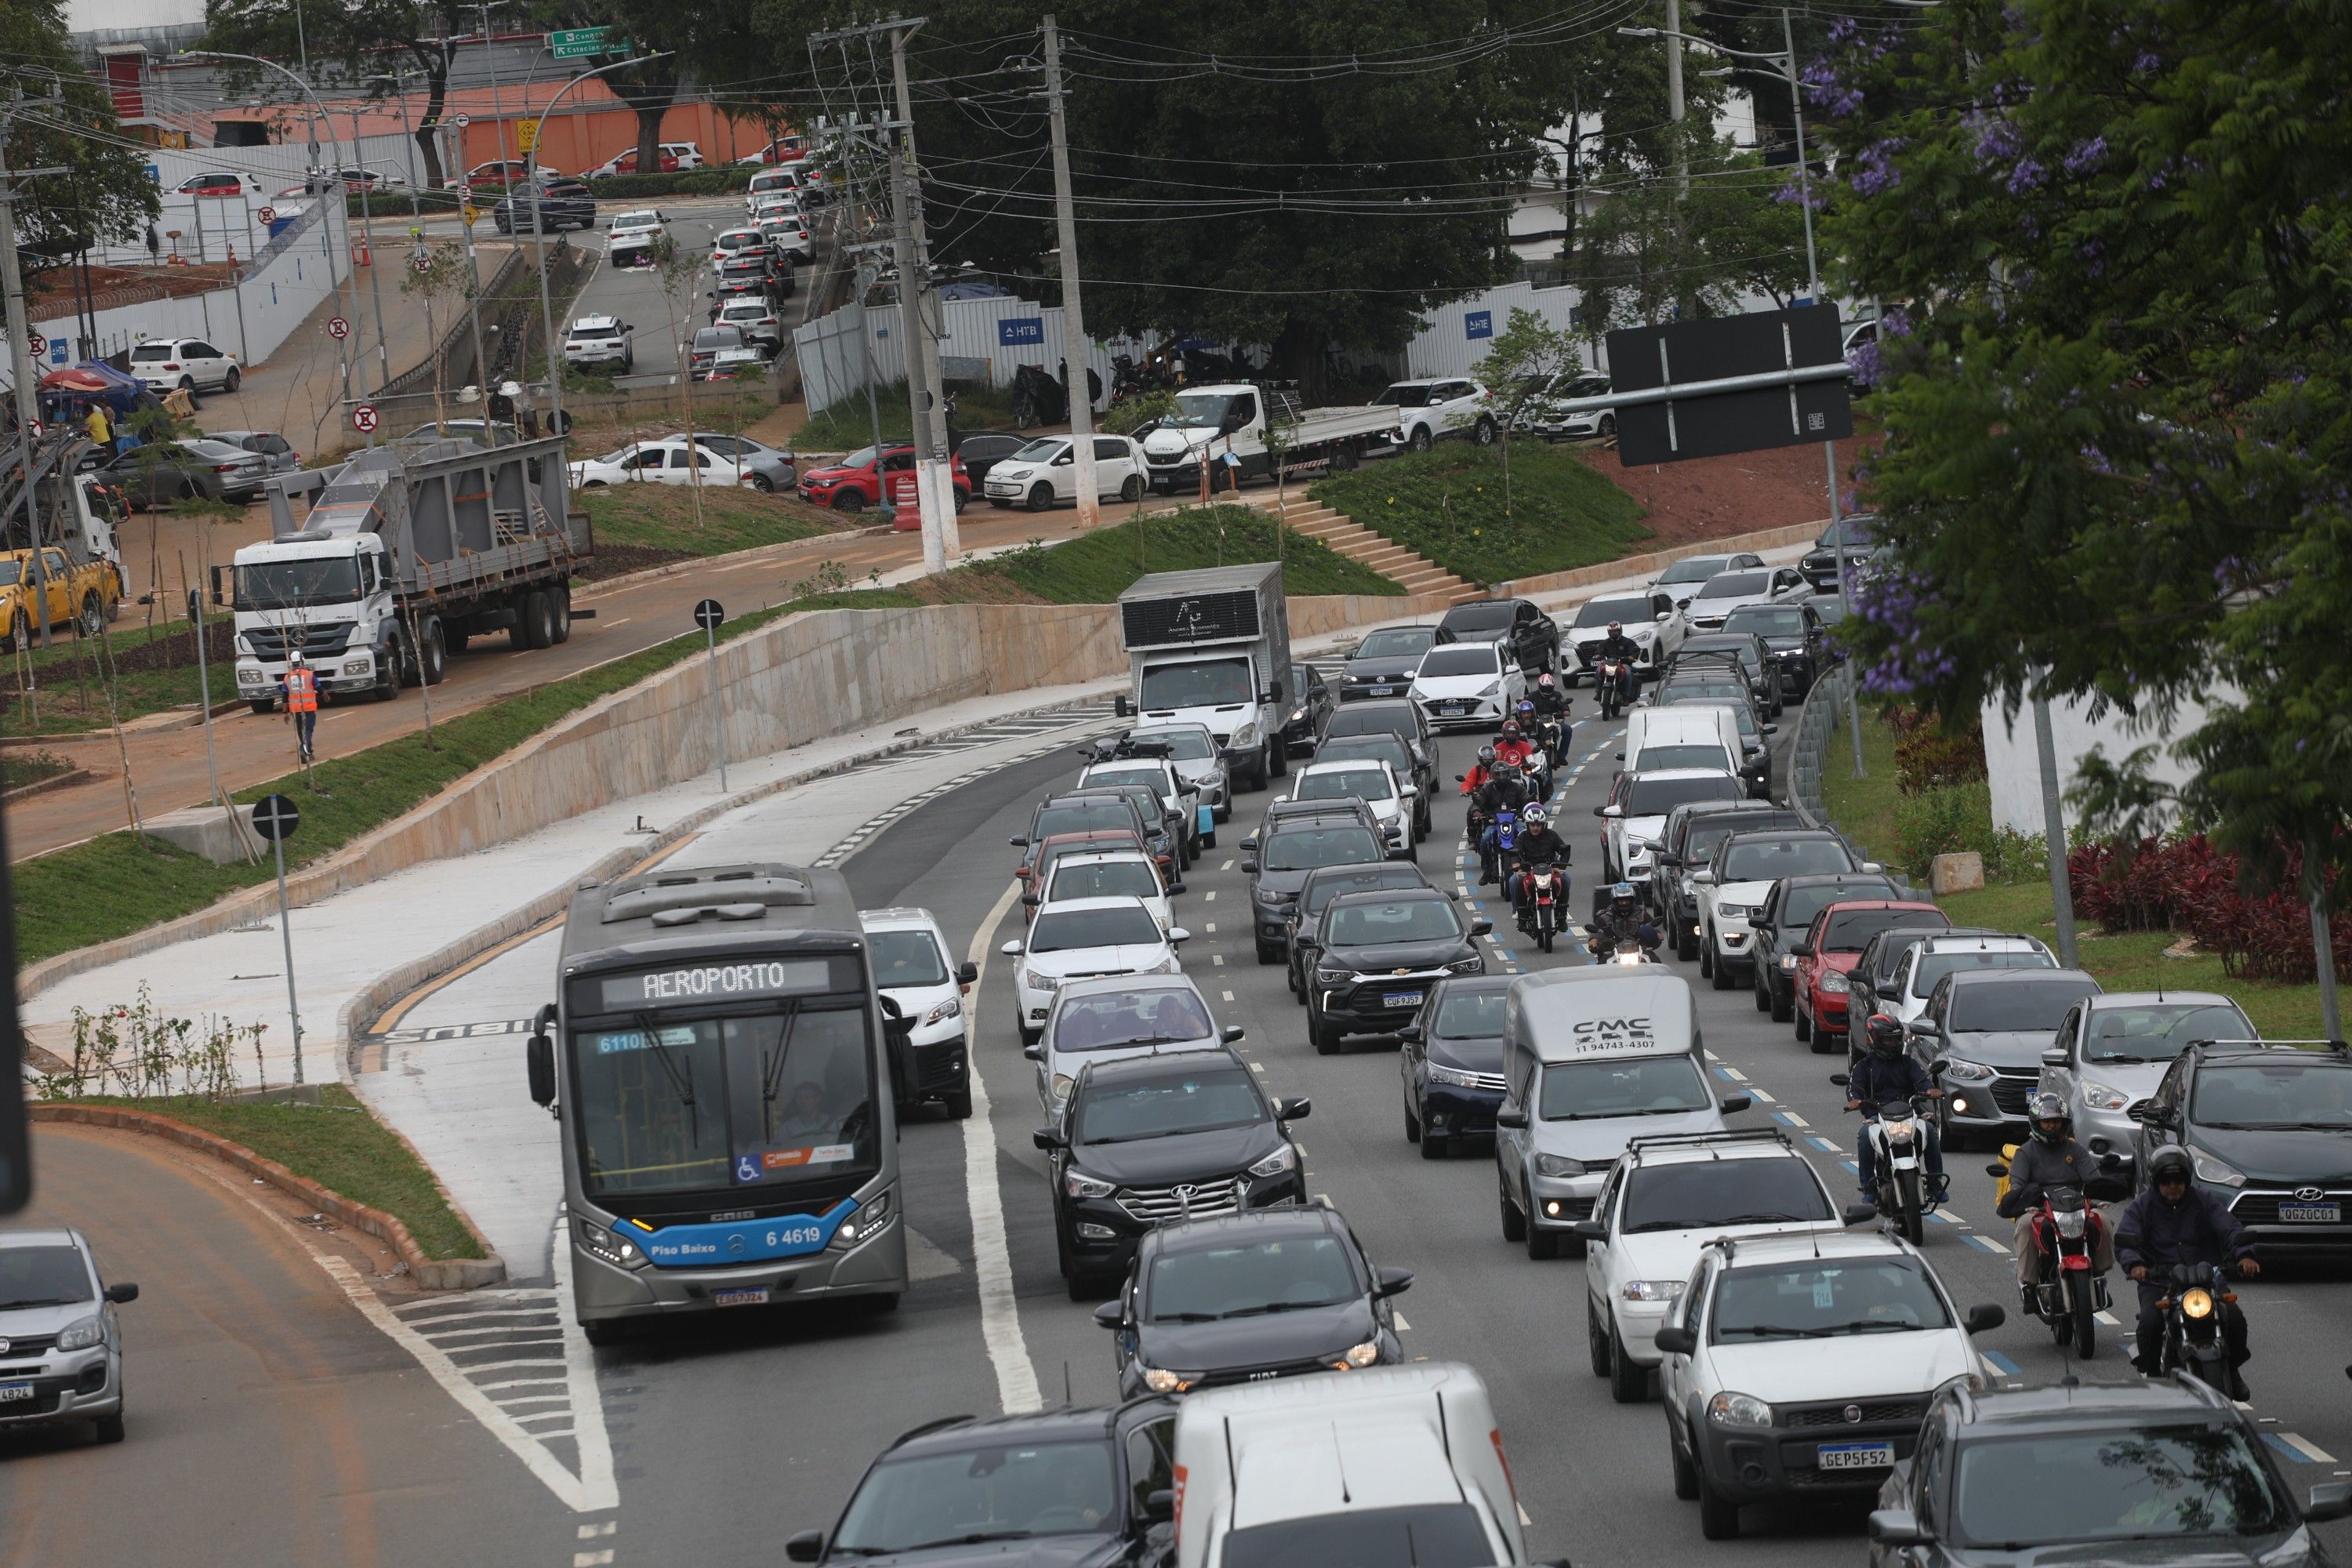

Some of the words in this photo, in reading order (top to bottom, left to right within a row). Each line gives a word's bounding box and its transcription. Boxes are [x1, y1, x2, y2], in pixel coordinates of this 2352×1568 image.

[1016, 325, 1037, 336] HTB
[643, 962, 785, 998] AEROPORTO
[1573, 1018, 1652, 1033] CMC
[1591, 1040, 1655, 1051] 94743-4307
[766, 1232, 777, 1247] 6
[782, 1227, 820, 1245] 4619
[651, 1246, 678, 1255] Piso
[681, 1243, 717, 1254] Baixo
[1817, 1292, 1831, 1305] 214
[0, 1388, 28, 1400] 4B24
[1825, 1450, 1887, 1467] GEP5F52
